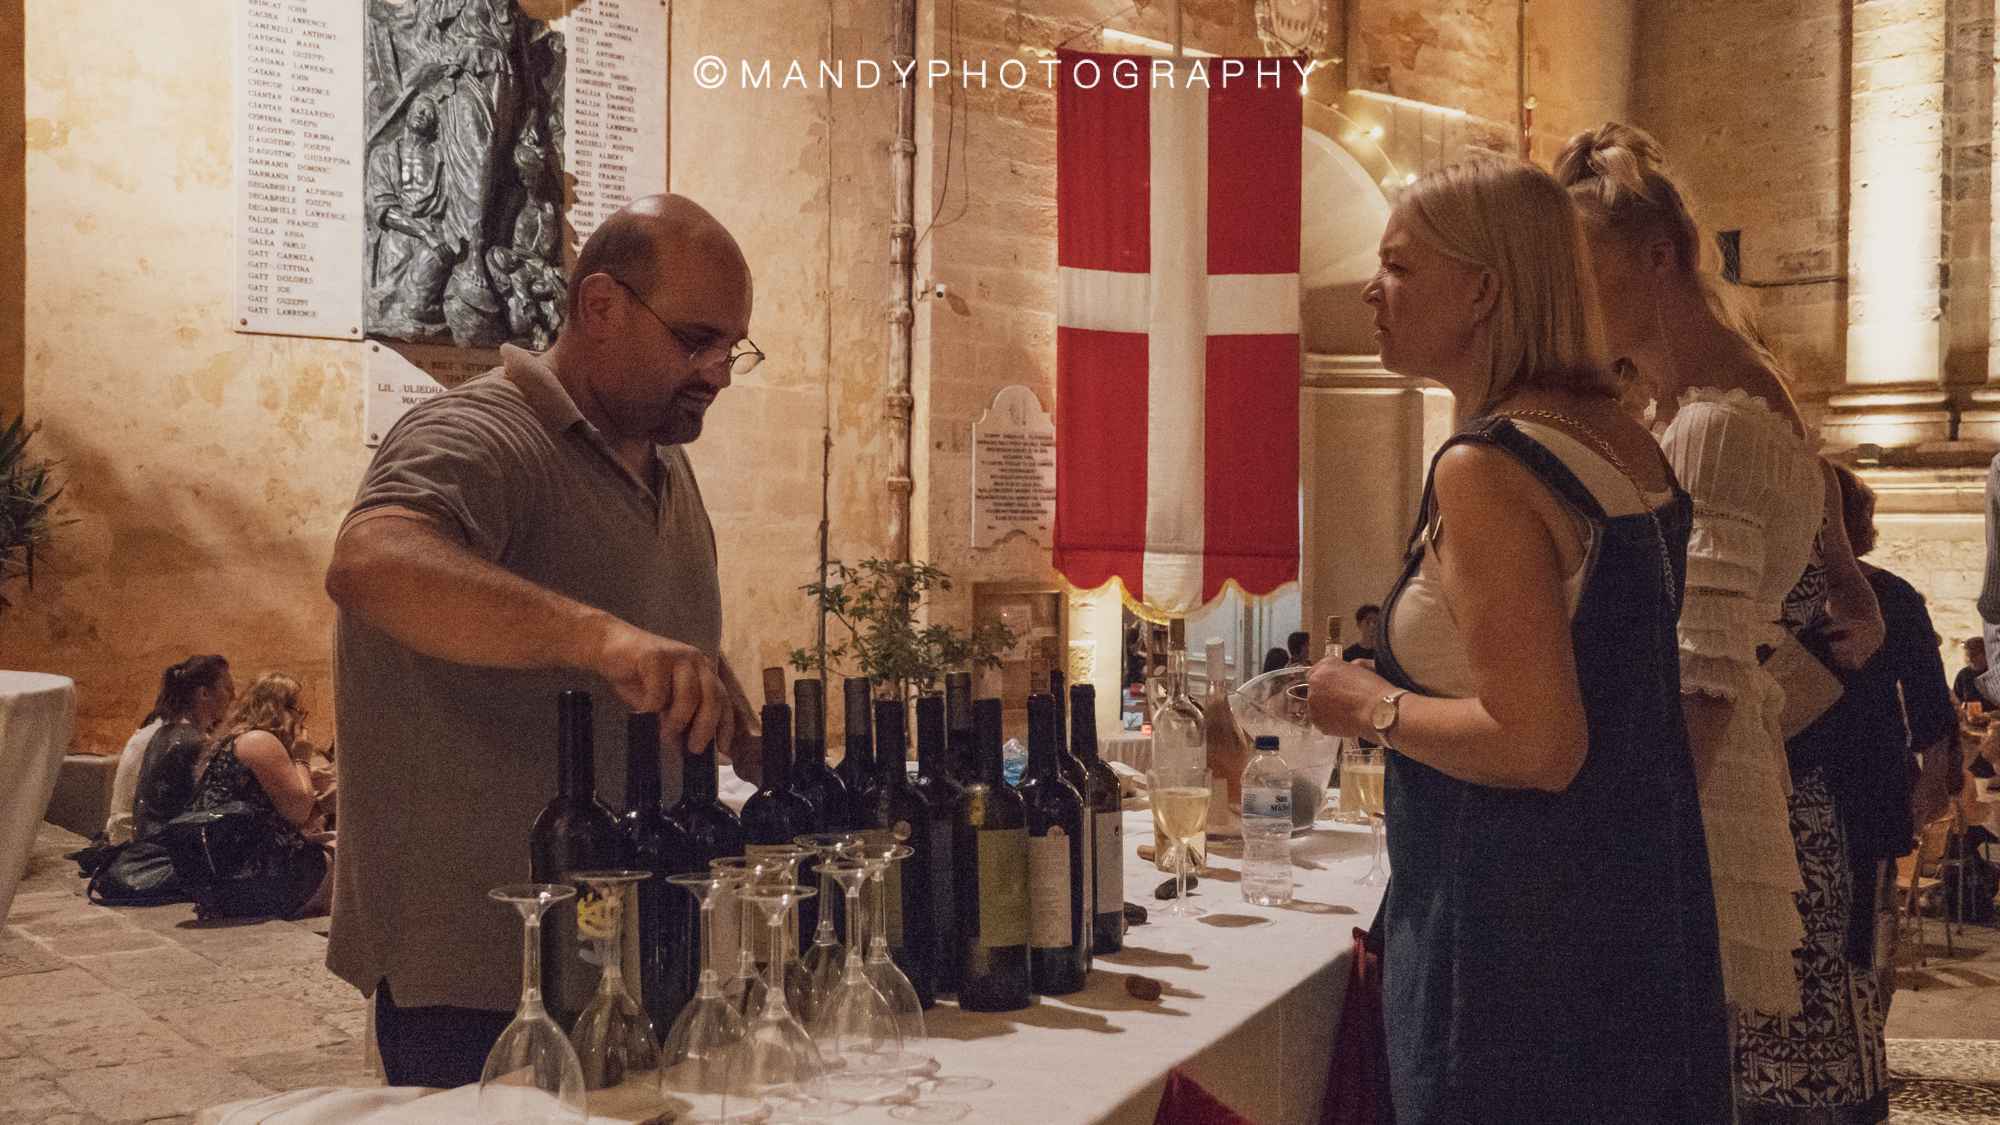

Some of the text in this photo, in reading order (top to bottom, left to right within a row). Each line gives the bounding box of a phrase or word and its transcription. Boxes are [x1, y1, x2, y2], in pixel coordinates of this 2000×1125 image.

[248, 249, 269, 258] GATT
[248, 261, 269, 269] GATT
[248, 272, 269, 281] GATT
[248, 283, 269, 293] GATT
[248, 295, 269, 304] GATT
[248, 306, 269, 315] GATT
